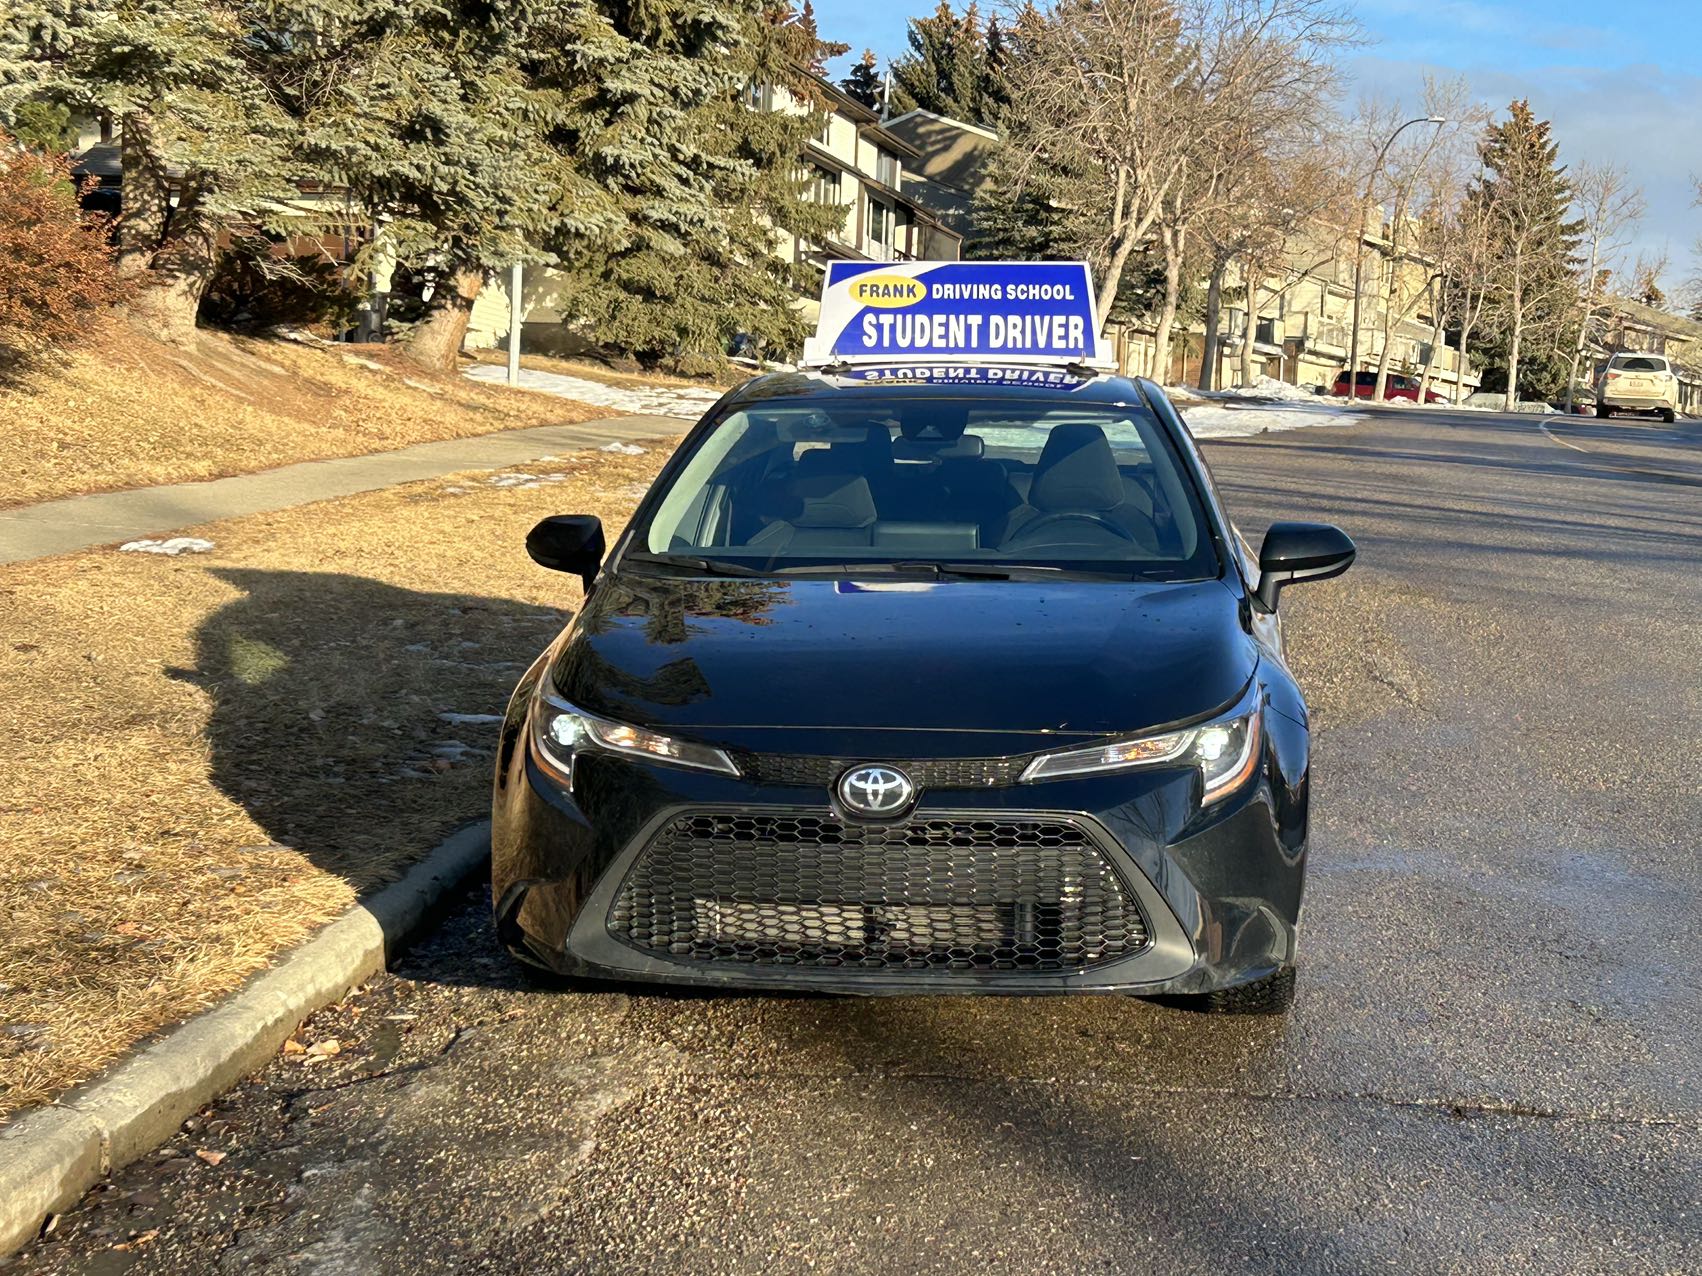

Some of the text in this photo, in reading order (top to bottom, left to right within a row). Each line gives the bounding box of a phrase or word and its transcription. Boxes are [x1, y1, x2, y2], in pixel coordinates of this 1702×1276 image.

[859, 283, 1075, 300] FRANK DRIVING SCHOOL
[862, 313, 1084, 349] STUDENT DRIVER
